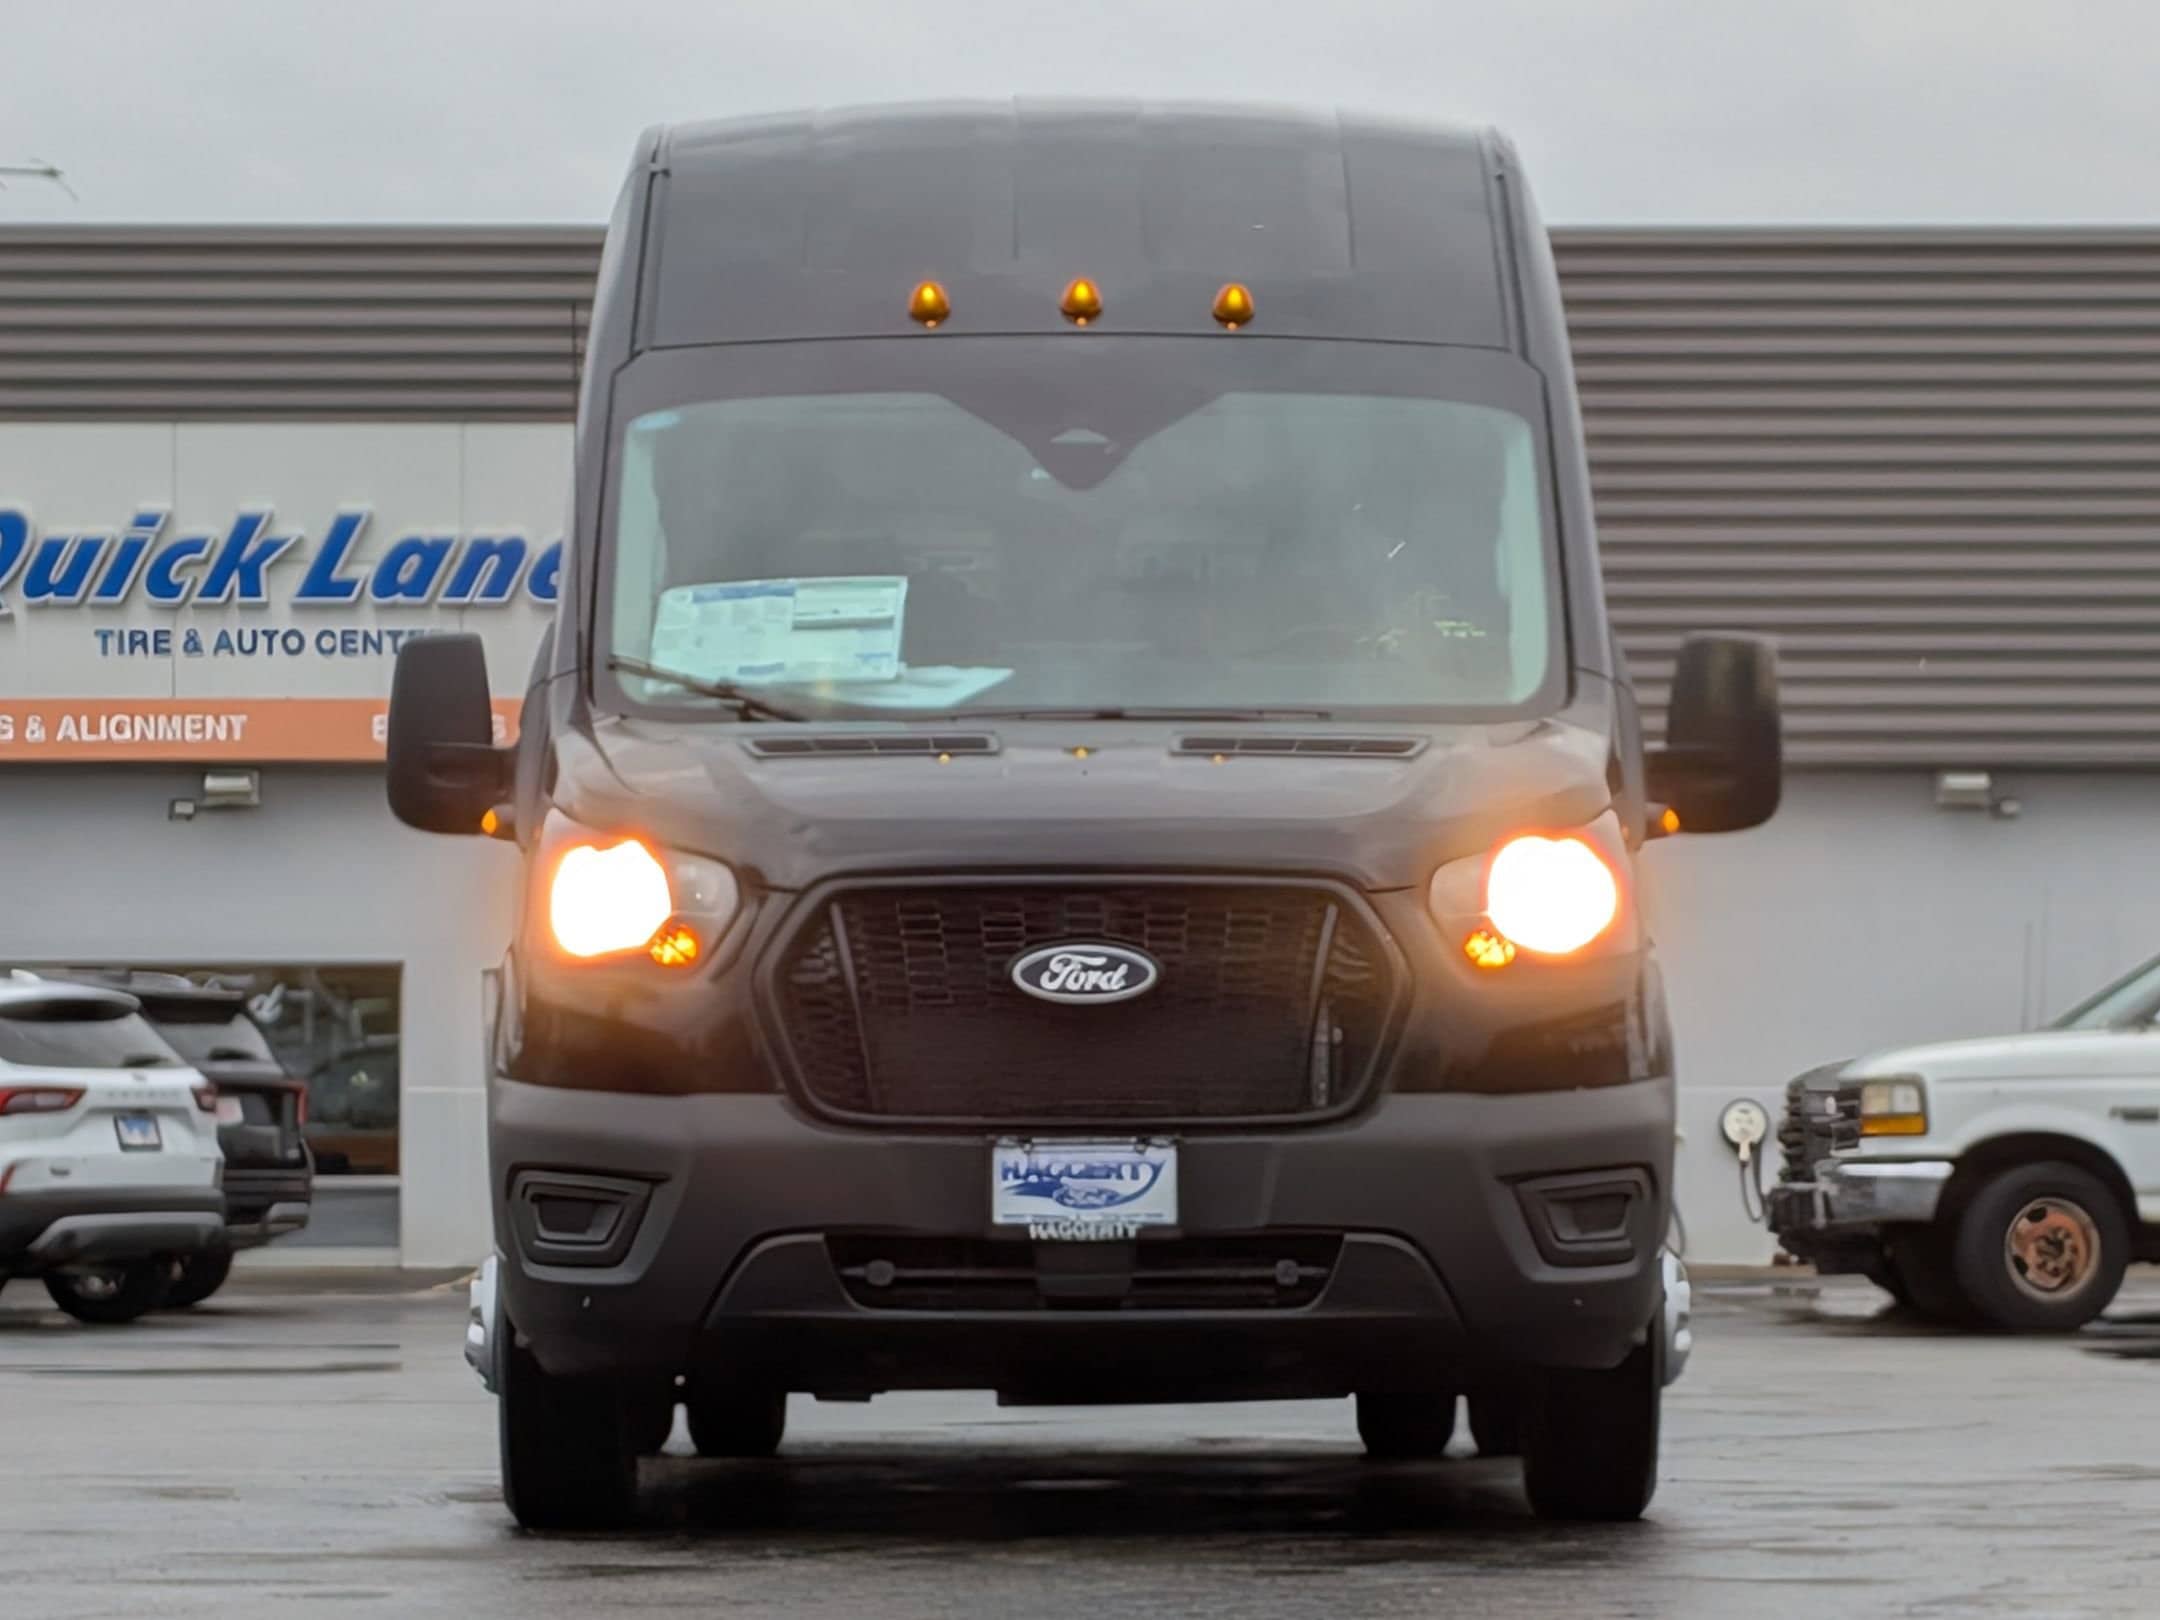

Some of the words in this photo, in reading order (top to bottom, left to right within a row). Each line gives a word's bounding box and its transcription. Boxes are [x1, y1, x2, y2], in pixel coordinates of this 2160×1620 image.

[95, 629, 171, 656] TIRE
[183, 628, 203, 657] &
[213, 628, 306, 656] AUTO
[315, 628, 446, 656] CENT
[25, 714, 45, 742] &
[56, 714, 247, 742] ALIGNMENT
[1040, 953, 1128, 991] Ford
